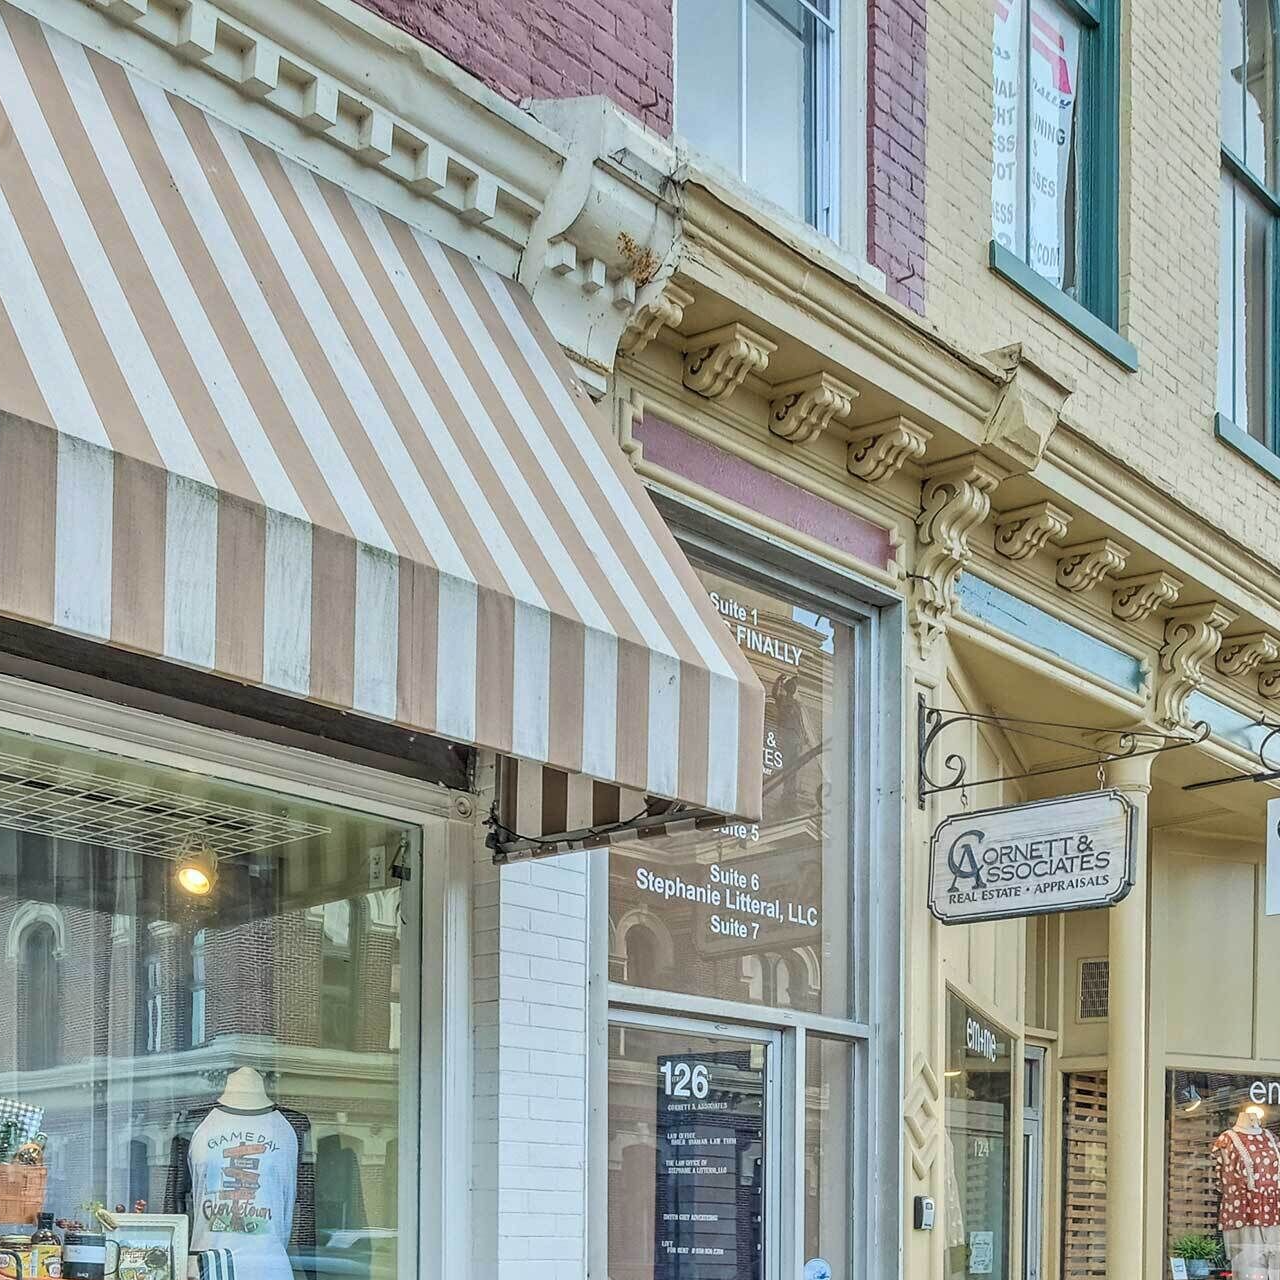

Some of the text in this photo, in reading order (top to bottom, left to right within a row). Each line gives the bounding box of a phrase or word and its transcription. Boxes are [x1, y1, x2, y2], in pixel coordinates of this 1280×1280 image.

[710, 592, 759, 626] Suite 1
[736, 625, 803, 666] FINALLY
[766, 732, 777, 748] &
[751, 825, 759, 842] 5
[948, 829, 1093, 878] CORNETT &
[710, 864, 760, 891] Suite 6
[949, 874, 1109, 905] REAL ESTATE APPRAISALS
[636, 867, 818, 926] Stephanie Litteral, LLC
[710, 915, 760, 940] Suite 7
[660, 1061, 709, 1099] 126
[974, 1137, 990, 1158] 124
